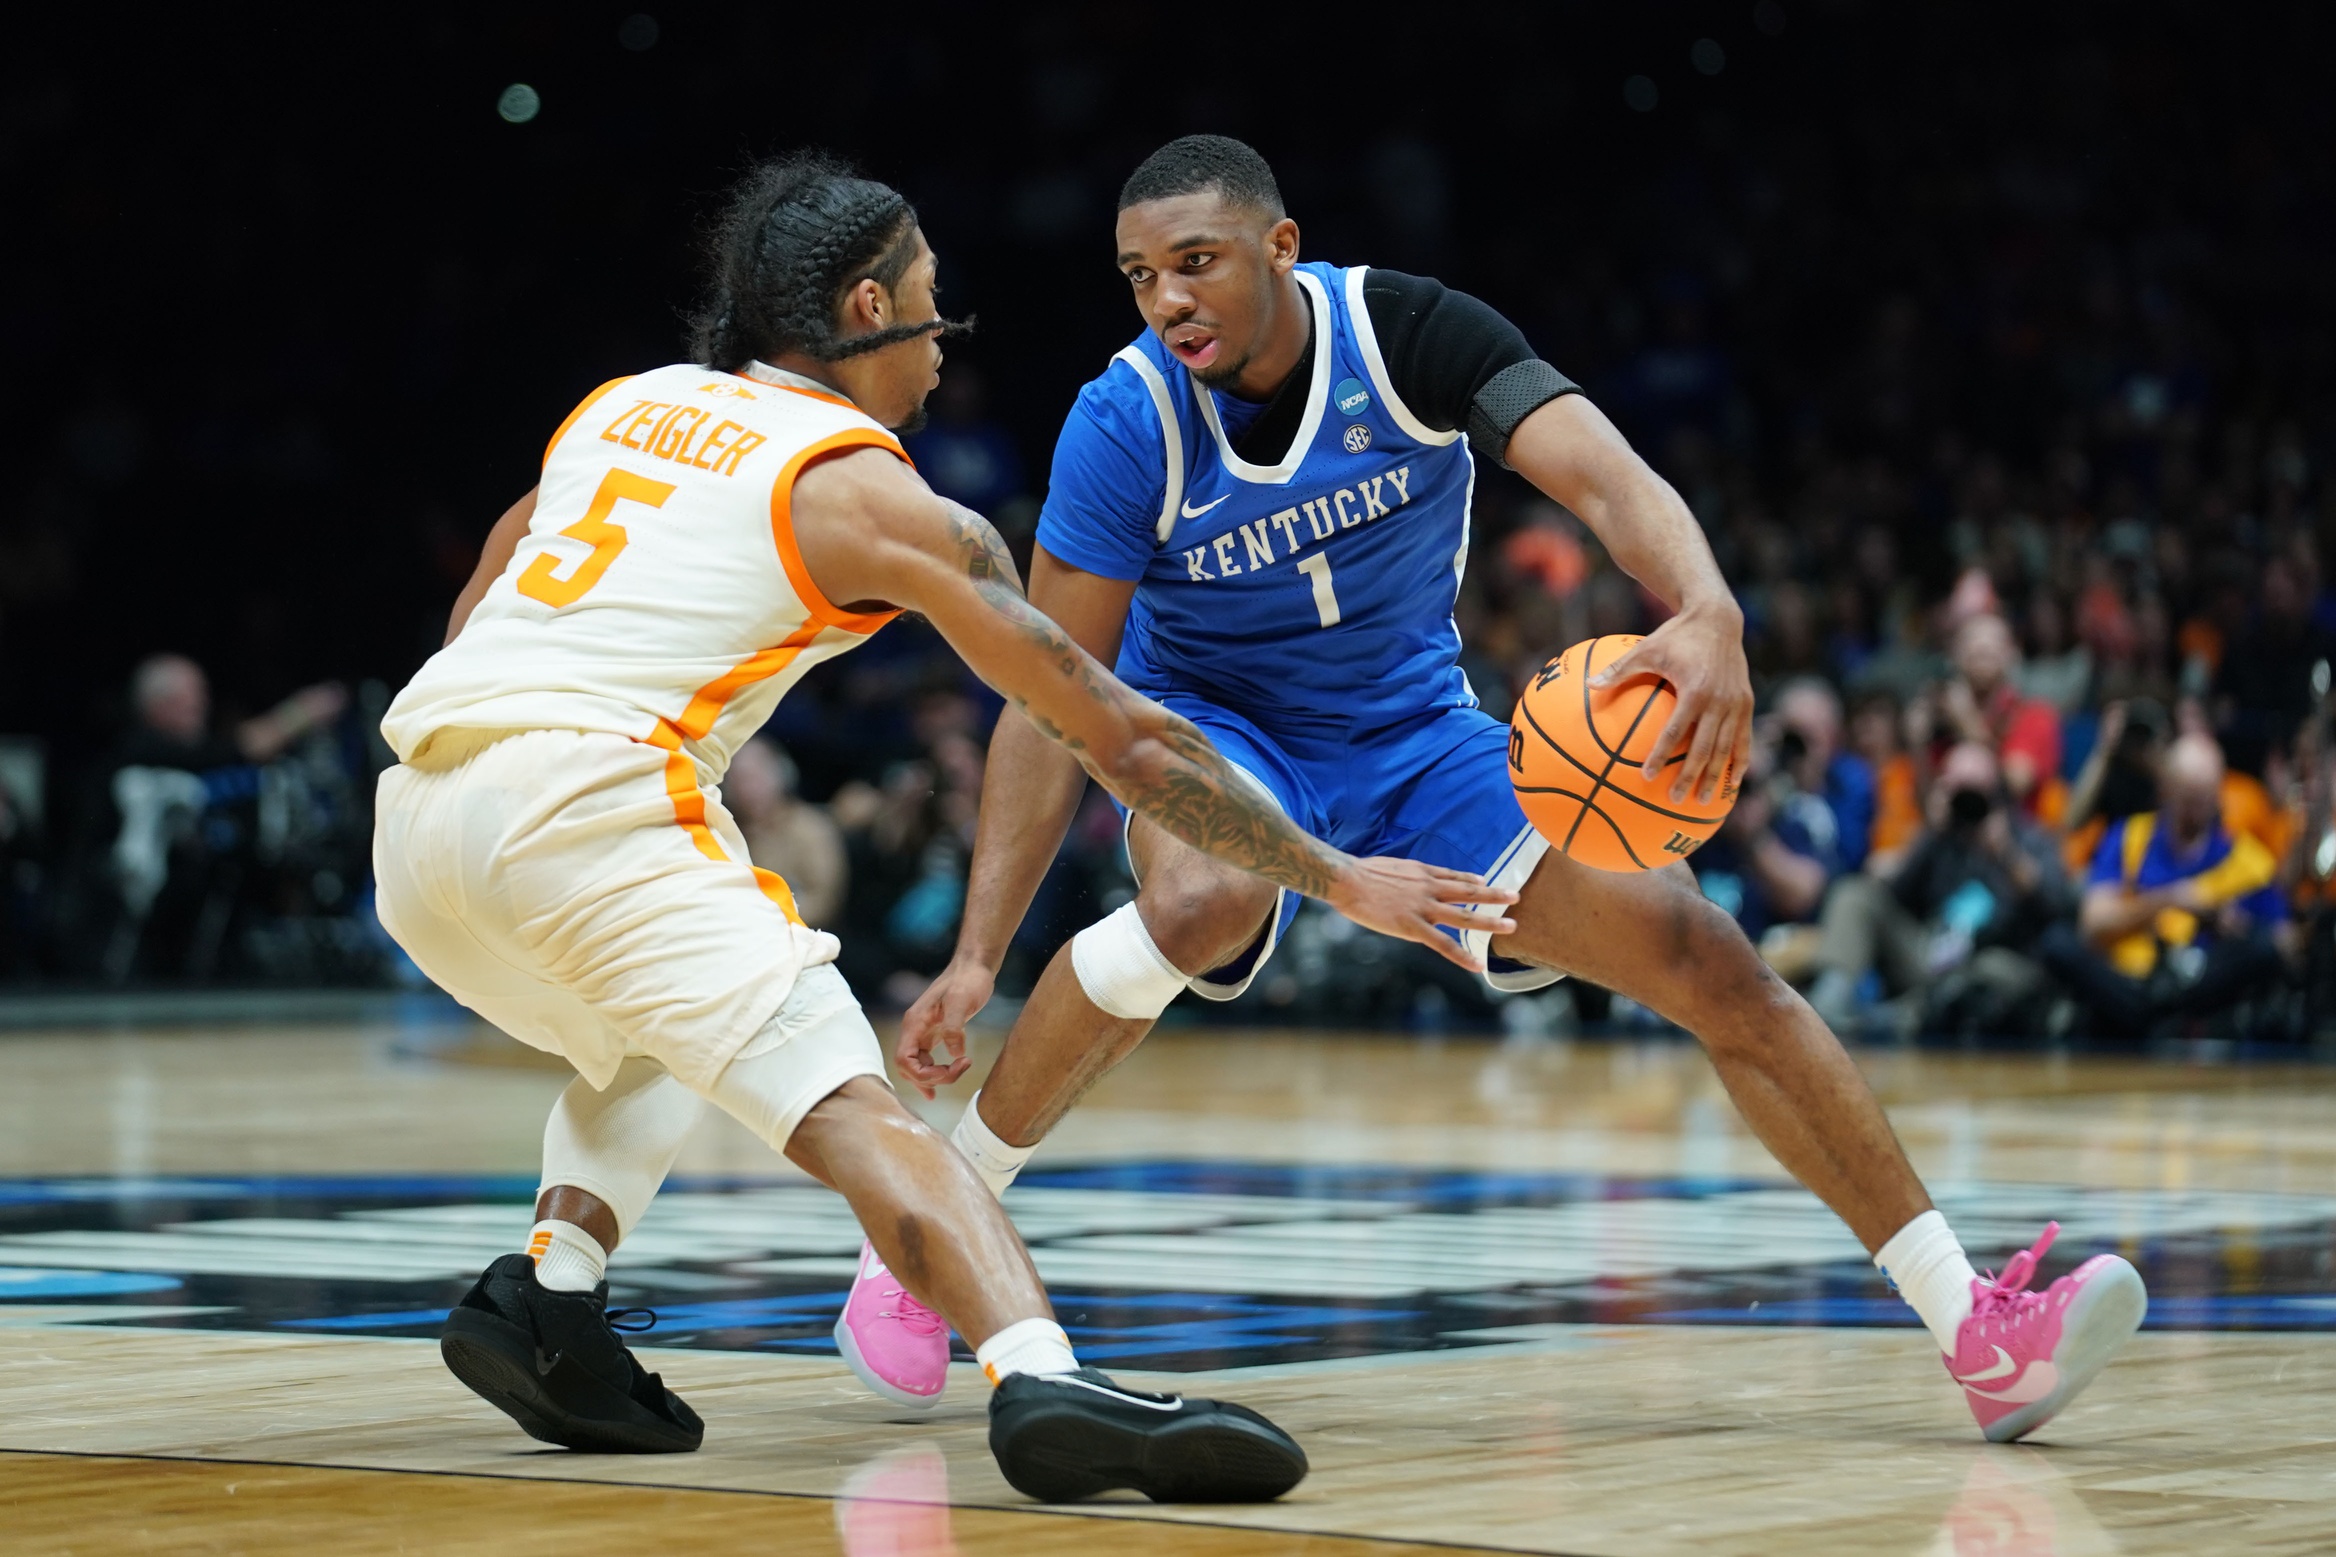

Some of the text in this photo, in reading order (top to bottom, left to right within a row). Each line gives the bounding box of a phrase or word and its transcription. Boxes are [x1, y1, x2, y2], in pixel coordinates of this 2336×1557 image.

[599, 400, 768, 477] ZEIGLER
[1341, 390, 1369, 411] NCAA
[1345, 426, 1370, 452] SEC
[516, 466, 678, 609] 5
[1182, 466, 1411, 582] KENTUCKY
[1296, 551, 1341, 629] 1
